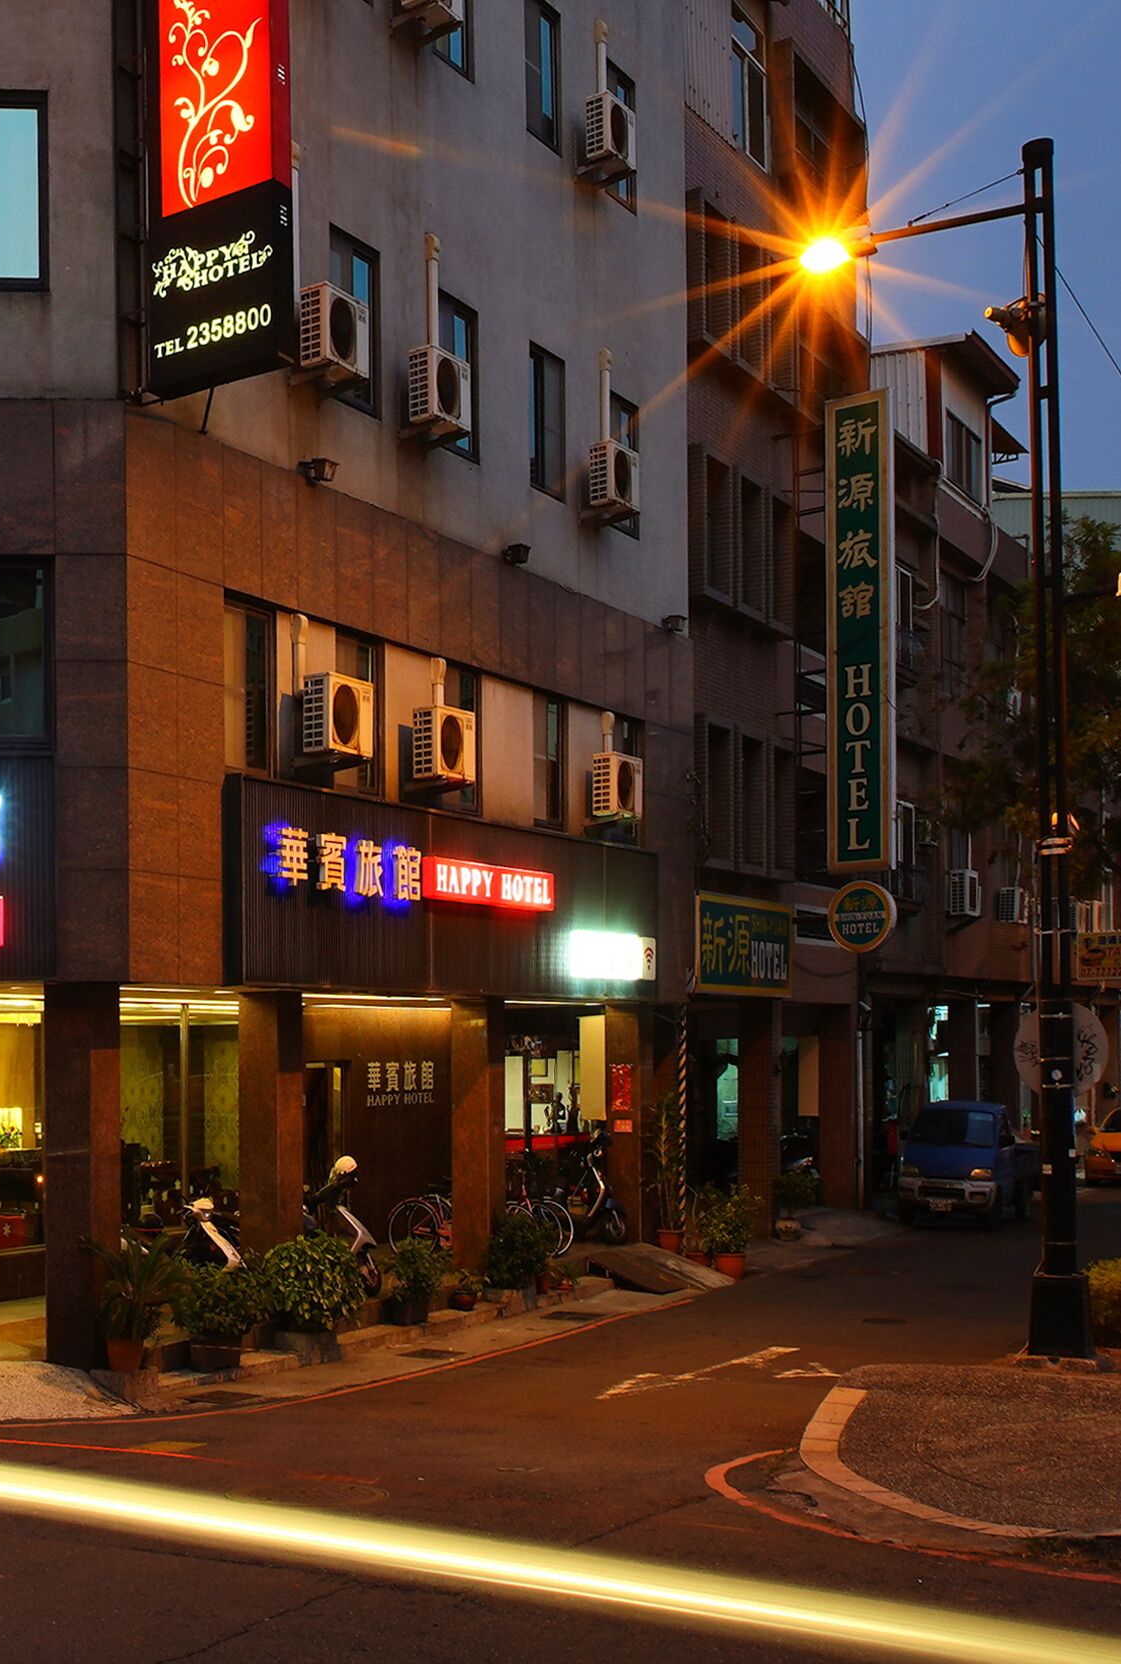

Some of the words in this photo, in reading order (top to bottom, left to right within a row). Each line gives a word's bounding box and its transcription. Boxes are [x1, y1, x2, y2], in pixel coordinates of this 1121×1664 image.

[161, 241, 237, 282] HAPPY
[193, 253, 266, 289] HOTEL
[153, 337, 184, 359] TEL
[186, 303, 272, 350] 2358800
[844, 663, 873, 851] HOTEL
[279, 826, 423, 902] 華賓旅館
[436, 863, 494, 895] HAPPY
[501, 871, 552, 906] HOTEL
[700, 911, 750, 977] 新源
[842, 922, 880, 935] HOTEL
[751, 940, 788, 981] HOTEL
[367, 1060, 434, 1092] 華賓旅館
[367, 1093, 400, 1107] HAPPY
[403, 1091, 434, 1105] HOTEL
